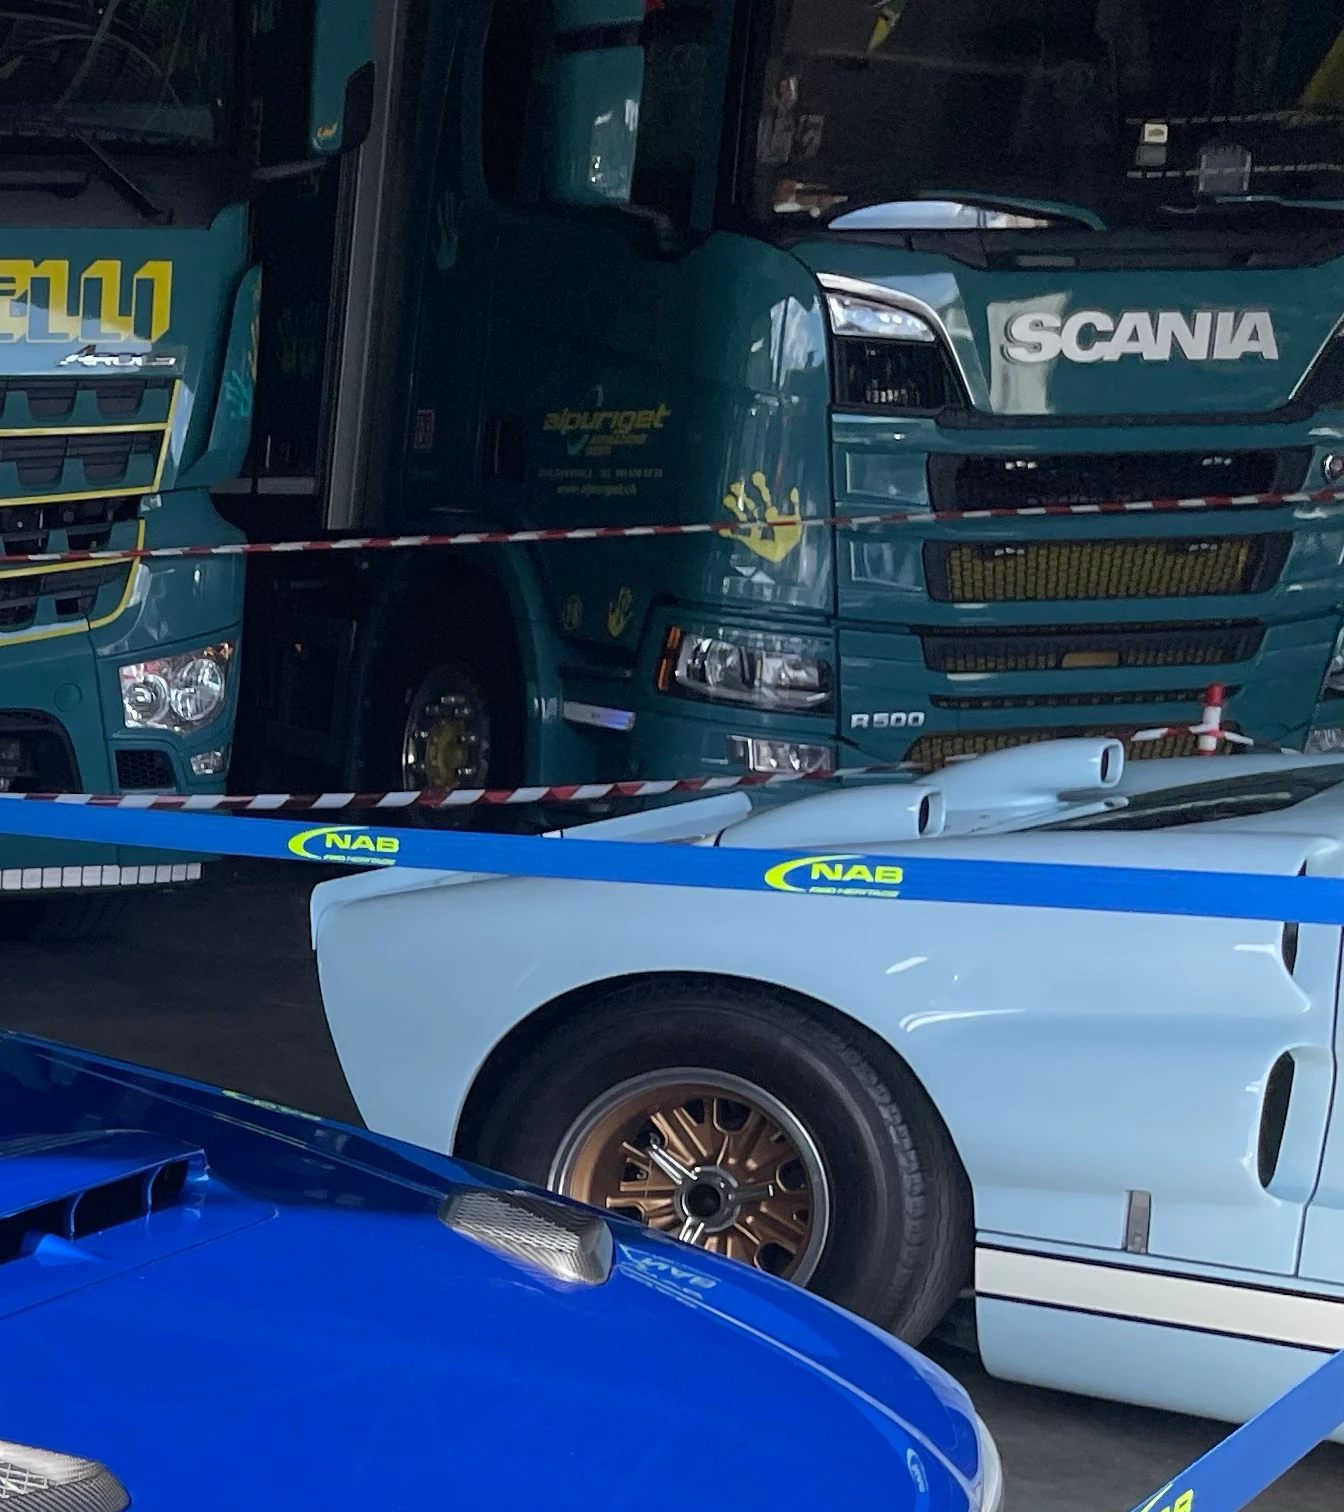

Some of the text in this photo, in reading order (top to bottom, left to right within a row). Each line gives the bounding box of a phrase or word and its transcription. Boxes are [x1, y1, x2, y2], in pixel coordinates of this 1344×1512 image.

[1004, 310, 1279, 363] SCANIA
[325, 832, 400, 853] NAB
[811, 863, 903, 884] NAB
